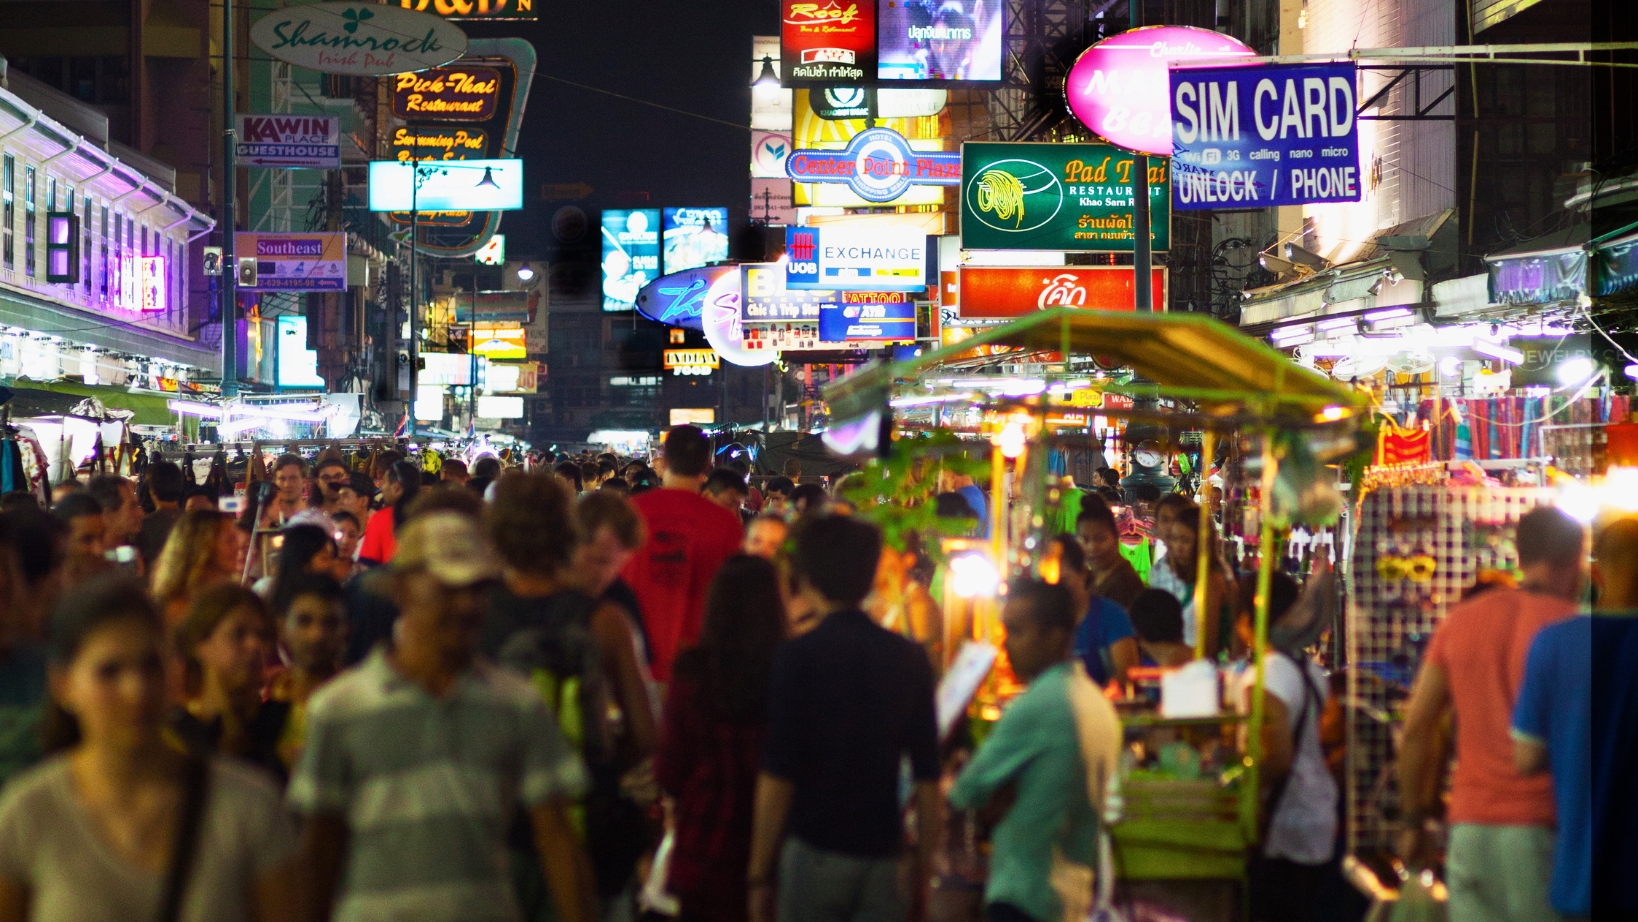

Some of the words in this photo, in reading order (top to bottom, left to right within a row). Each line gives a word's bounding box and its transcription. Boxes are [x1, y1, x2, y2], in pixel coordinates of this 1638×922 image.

[790, 3, 859, 24] Roof
[272, 20, 443, 53] Shamrock
[1150, 41, 1201, 56] Charlie
[318, 51, 358, 64] Irish
[364, 53, 395, 68] Pub
[396, 72, 496, 93] Pick-Thai
[406, 94, 484, 112] Restaurant
[1175, 80, 1240, 144] SIM
[1253, 77, 1354, 141] CARD
[244, 117, 330, 142] KAWIN
[285, 134, 329, 143] PLACE
[454, 130, 484, 149] Pool
[868, 134, 893, 142] HOTEL
[239, 145, 335, 157] GUESTHOUSE
[1227, 150, 1241, 161] 3G
[1249, 149, 1280, 161] calling
[1289, 150, 1313, 159] nano
[1321, 146, 1348, 157] micro
[795, 155, 857, 175] Center
[862, 157, 911, 176] Point
[915, 158, 962, 177] Plaza
[1065, 156, 1111, 184] Pad
[1116, 159, 1168, 184] Tai
[853, 176, 889, 196] SHOPPING
[890, 176, 907, 193] MALL
[1178, 170, 1259, 204] UNLOCK
[1270, 169, 1279, 200] /
[1291, 167, 1357, 199] PHONE
[1079, 198, 1103, 207] Khao
[257, 241, 322, 255] Southeast
[825, 247, 921, 260] EXCHANGE
[788, 262, 818, 275] UOB
[843, 292, 902, 303] TATTOO
[747, 304, 768, 316] Chic
[769, 304, 778, 316] &
[780, 304, 800, 319] Trip
[666, 352, 718, 364] INDIAN
[673, 366, 712, 376] FOOD
